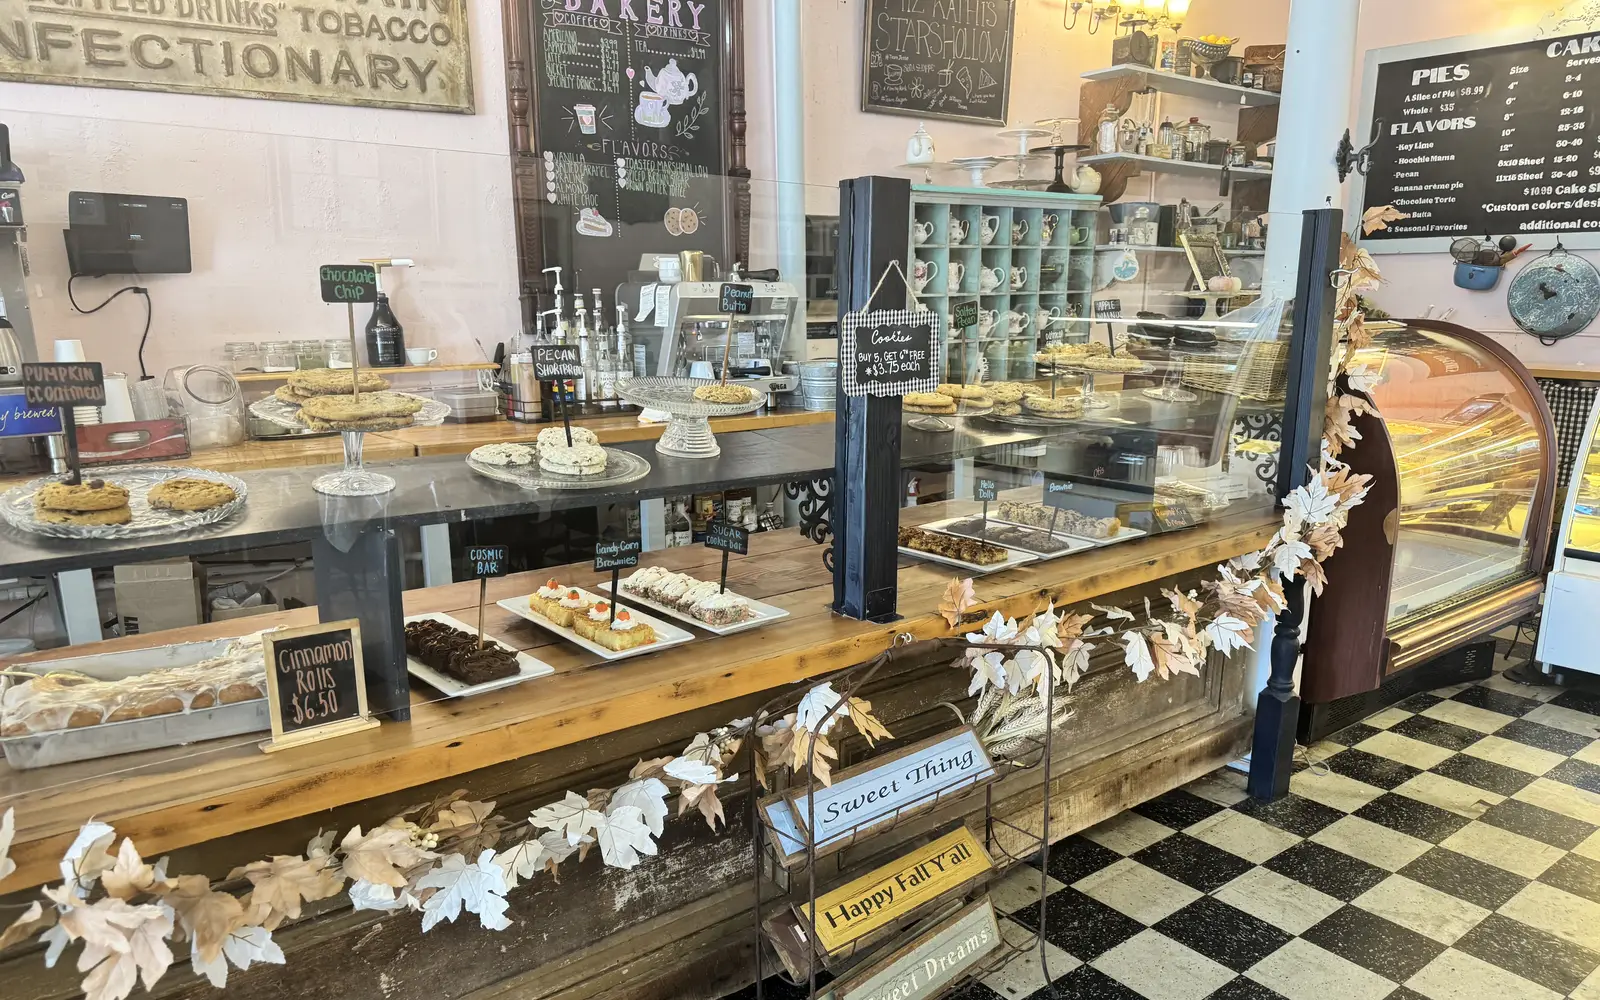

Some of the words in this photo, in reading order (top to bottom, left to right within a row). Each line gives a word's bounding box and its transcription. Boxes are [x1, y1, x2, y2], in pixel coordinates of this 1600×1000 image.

[293, 7, 451, 46] TOBACCO
[563, 13, 598, 28] COFFEE
[656, 26, 688, 39] DRINKS
[634, 39, 648, 52] TEA
[544, 51, 561, 64] LATTE
[1566, 56, 1600, 68] Serves
[1411, 63, 1470, 86] PIES
[1509, 66, 1529, 75] Size
[1565, 73, 1581, 83] 2-4
[1404, 95, 1411, 103] A
[1411, 93, 1431, 102] Slice
[1432, 91, 1442, 99] of
[1442, 89, 1455, 98] Pie
[1460, 85, 1484, 97] $8.99
[1562, 89, 1583, 99] 6-10
[1440, 103, 1455, 112] $35
[1390, 116, 1477, 136] FLAVORS
[1557, 121, 1585, 132] 25-35
[601, 138, 668, 158] FLAVORS
[1414, 141, 1434, 150] Lime
[1555, 138, 1583, 148] 30-40
[553, 152, 586, 164] VANILLA
[1398, 155, 1430, 164] Hoochie
[1430, 154, 1455, 162] Mama
[1497, 159, 1518, 167] 8x10
[1518, 157, 1545, 166] Sheet
[555, 162, 579, 174] SALTED
[580, 163, 610, 179] CARAMEL
[625, 157, 656, 171] TOASTED
[656, 160, 709, 179] MARSHMALLOW
[1517, 172, 1544, 181] Sheet
[1551, 170, 1578, 179] 30-40
[555, 183, 589, 194] ALMOND
[1450, 181, 1463, 190] pie
[1523, 185, 1552, 196] $10.99
[1555, 183, 1586, 195] Cake
[556, 192, 580, 205] WHITE
[580, 193, 599, 206] CHOC
[1434, 196, 1456, 204] Torte
[1412, 211, 1432, 219] Butta
[1430, 223, 1468, 232] Favorites
[1519, 219, 1581, 231] additional
[321, 267, 375, 284] Chocolate
[334, 284, 364, 300] Chip
[724, 285, 754, 299] Peanut
[722, 298, 746, 312] Butta
[955, 303, 976, 318] Salted
[956, 314, 976, 328] Pecan
[871, 329, 913, 345] Cookies
[537, 348, 575, 361] PECAN
[858, 352, 872, 362] BUY
[874, 352, 882, 363] 5,
[883, 351, 897, 361] GET
[909, 350, 925, 361] FREE
[901, 361, 920, 372] each
[24, 365, 95, 382] PUMPKIN
[26, 385, 43, 403] CC
[14, 406, 56, 421] brewed
[980, 479, 994, 489] Hello
[978, 489, 994, 499] Dolly
[712, 524, 742, 540] SUGAR
[729, 539, 743, 551] bar
[470, 548, 503, 561] COSMIC
[476, 561, 498, 575] BAR
[596, 556, 637, 570] Brownies
[279, 639, 353, 674] Cinnamon
[291, 689, 338, 725] $6.50
[823, 779, 902, 824] Sweet
[905, 749, 977, 786] Thing
[824, 885, 895, 930] Happy
[894, 865, 932, 892] Fall
[930, 842, 972, 873] Y'all
[923, 925, 993, 982] Dreams
